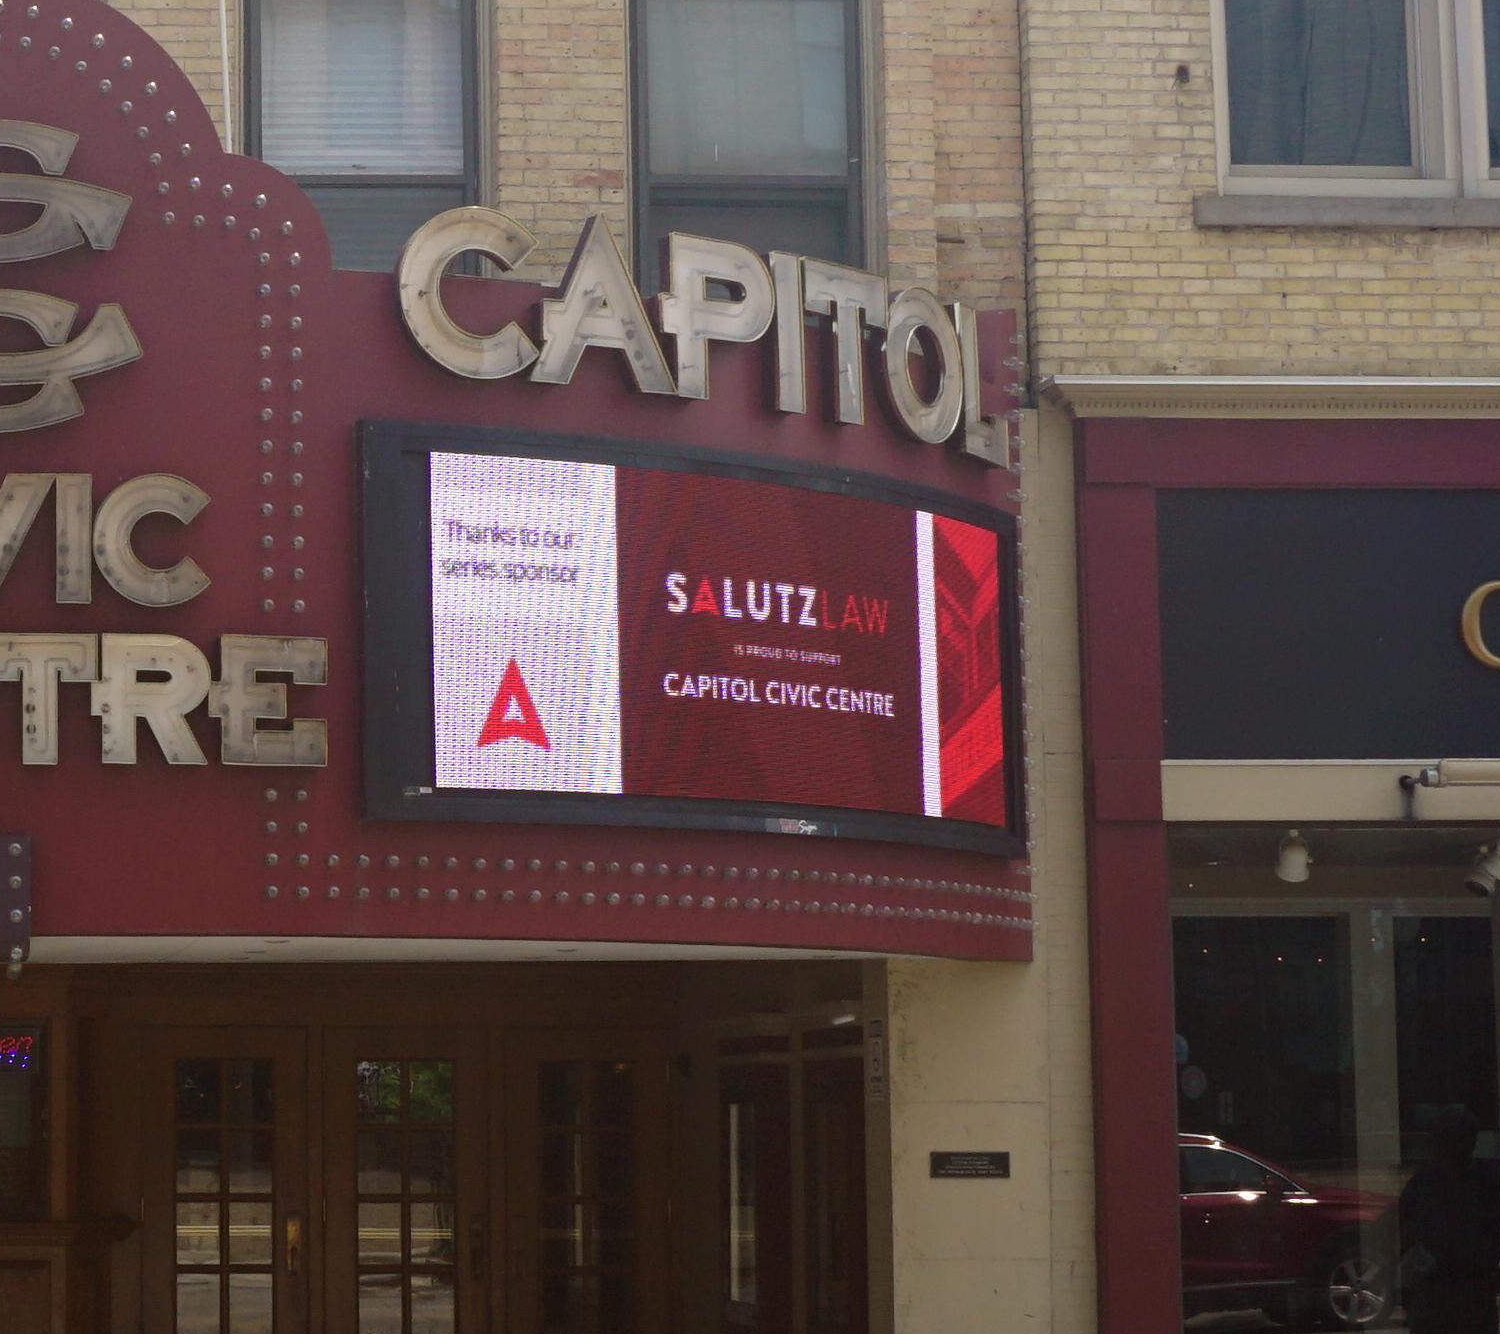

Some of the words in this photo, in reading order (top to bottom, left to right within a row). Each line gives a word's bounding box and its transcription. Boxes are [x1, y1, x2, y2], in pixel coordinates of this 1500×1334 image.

[400, 206, 1009, 467] CAPITOL
[663, 671, 762, 703] CAPITOL
[765, 680, 822, 709] CIVIC
[825, 687, 896, 717] CENTRE
